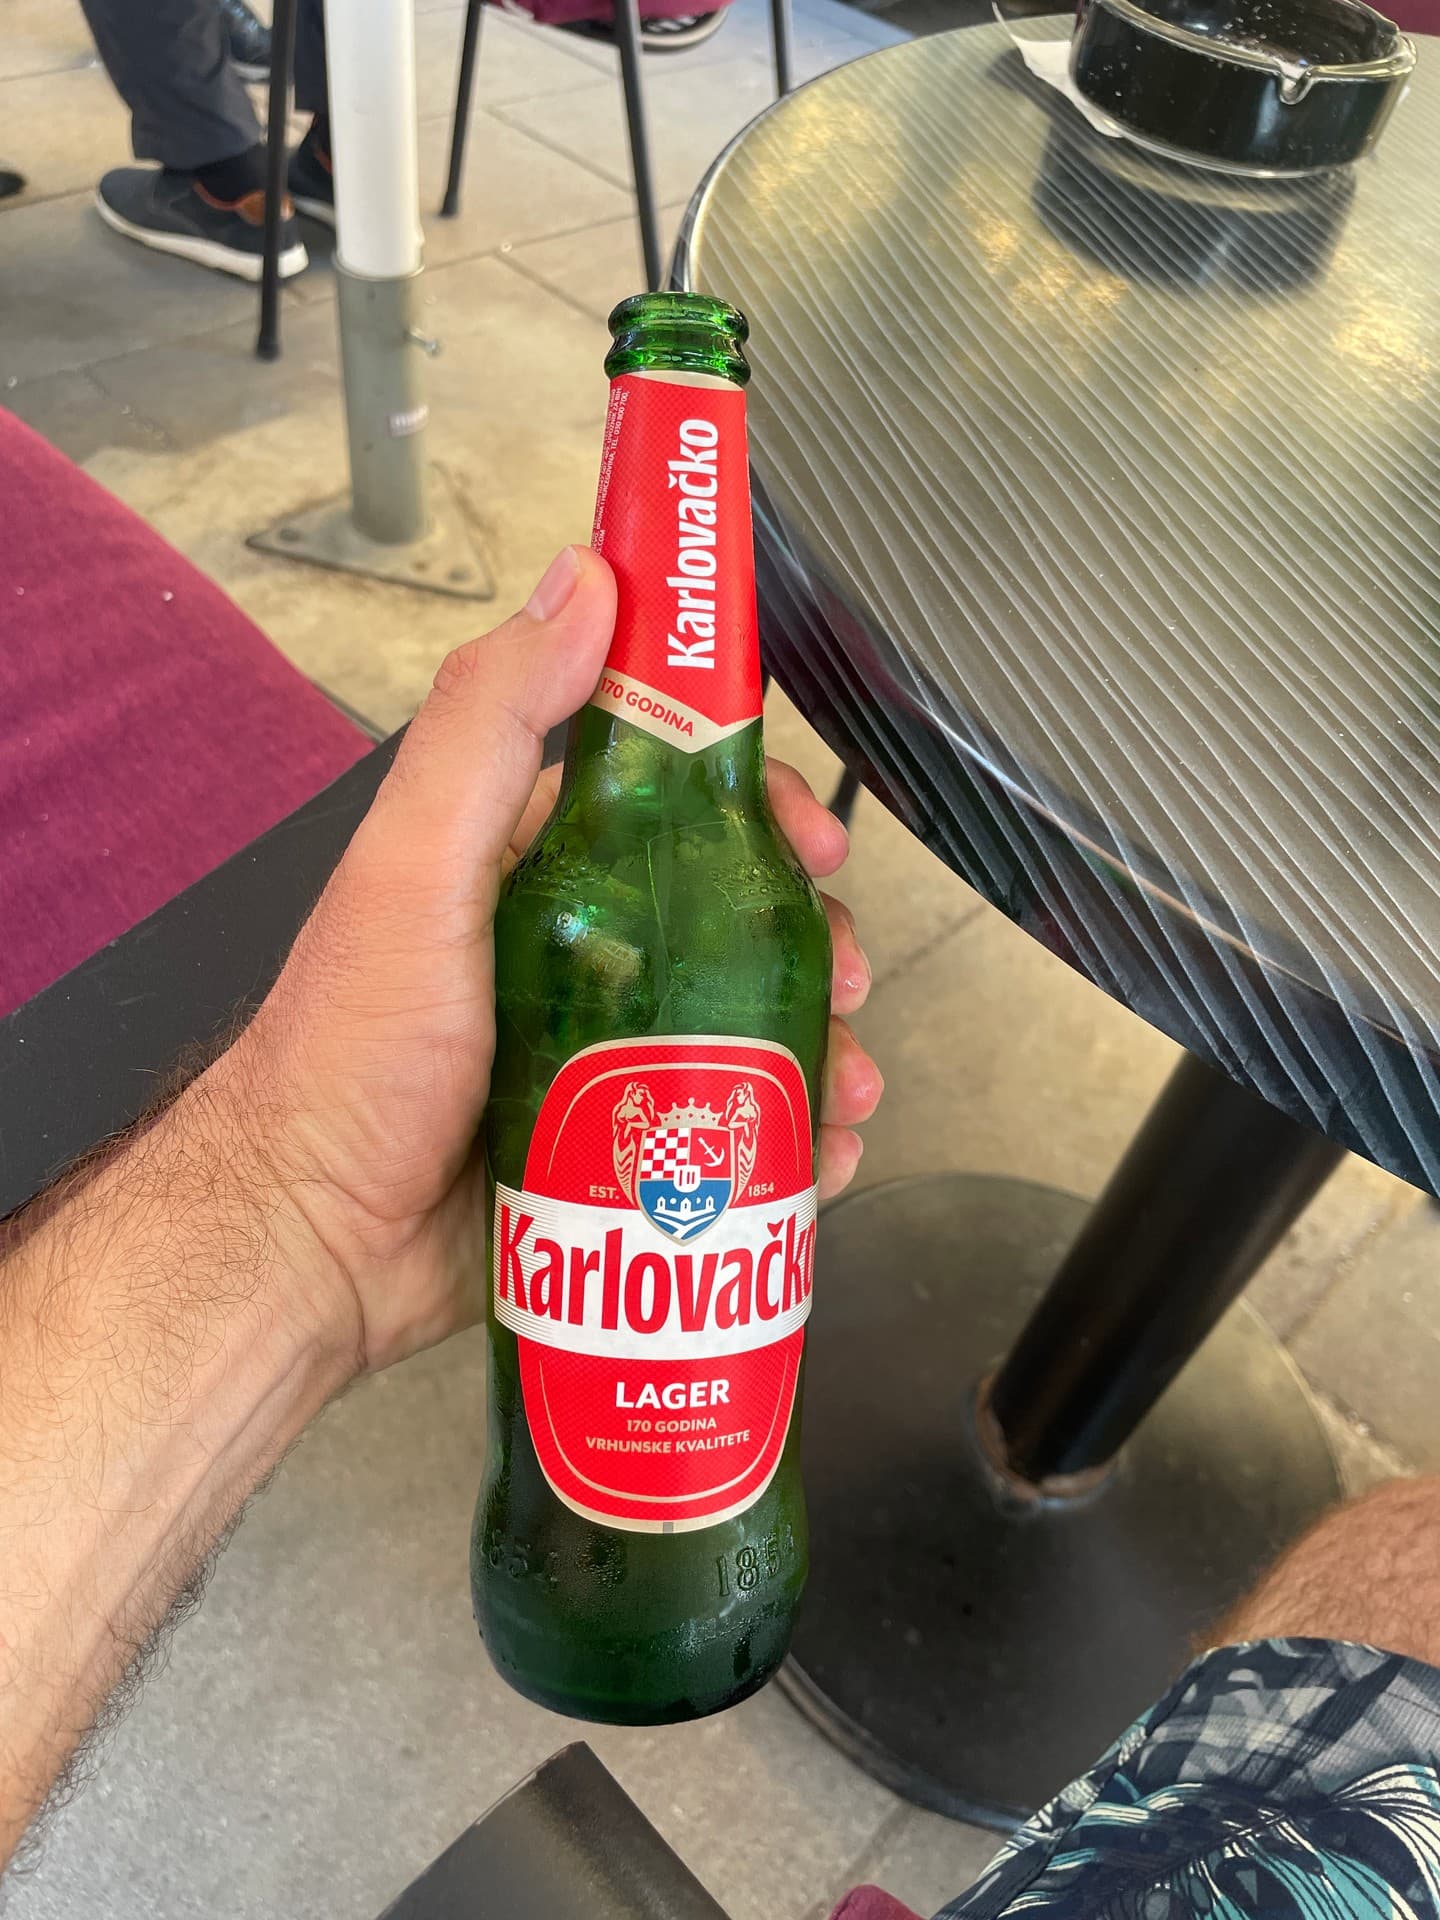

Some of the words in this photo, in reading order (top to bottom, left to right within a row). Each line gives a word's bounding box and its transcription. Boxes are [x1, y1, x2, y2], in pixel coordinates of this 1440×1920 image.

[666, 418, 718, 670] Karlovačko
[600, 677, 623, 699] 170
[626, 692, 694, 737] GODINA
[589, 1184, 620, 1199] EST.
[748, 1182, 774, 1197] 1854
[500, 1206, 817, 1334] Karlovačko
[615, 1379, 729, 1410] LAGER
[626, 1420, 652, 1432] 170
[656, 1417, 717, 1432] GODINA
[586, 1436, 671, 1453] VRHUNSKE
[676, 1431, 750, 1452] KVALITETE
